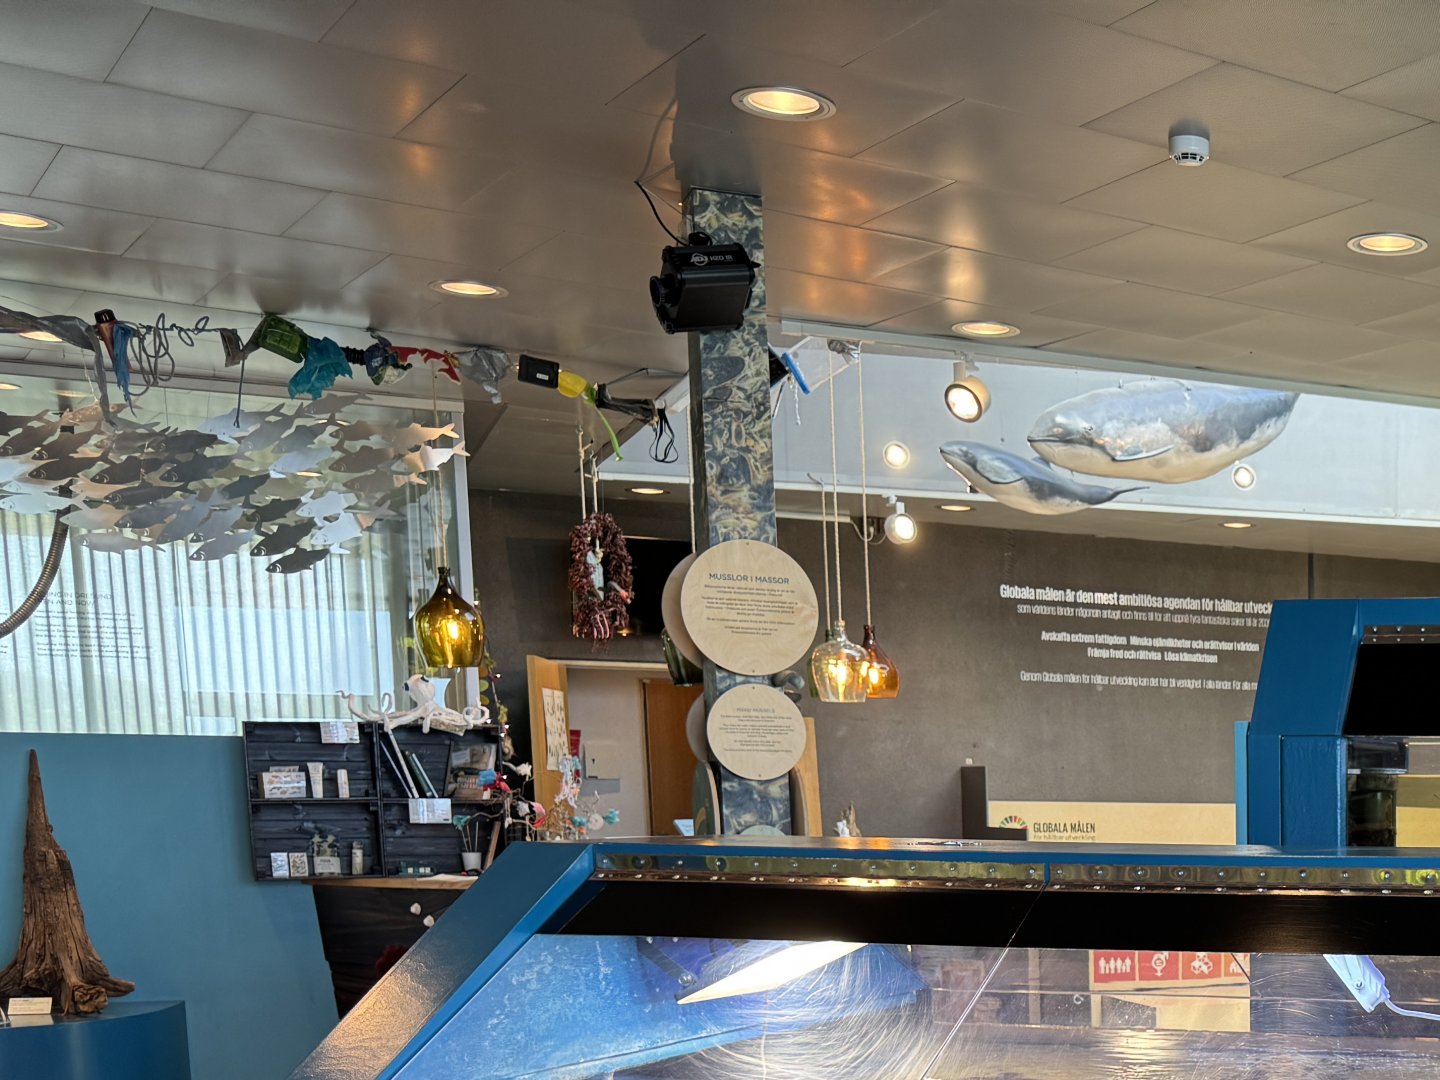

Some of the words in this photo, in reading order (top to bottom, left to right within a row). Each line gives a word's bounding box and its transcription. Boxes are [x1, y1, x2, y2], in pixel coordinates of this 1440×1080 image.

[709, 572, 748, 582] MUSSLOR
[755, 576, 790, 585] MASSOR
[1000, 584, 1035, 600] Globala
[1036, 586, 1065, 602] målen
[1065, 588, 1075, 602] är
[1076, 590, 1093, 604] den
[1094, 592, 1118, 605] mest
[1119, 592, 1162, 608] ambitiösa
[1164, 597, 1200, 610] agendan
[1201, 598, 1213, 611] för
[1215, 598, 1243, 613] hållbar
[1244, 601, 1272, 615] utveck
[1033, 822, 1068, 833] GLOBALA
[1070, 820, 1096, 834] MÅLEN
